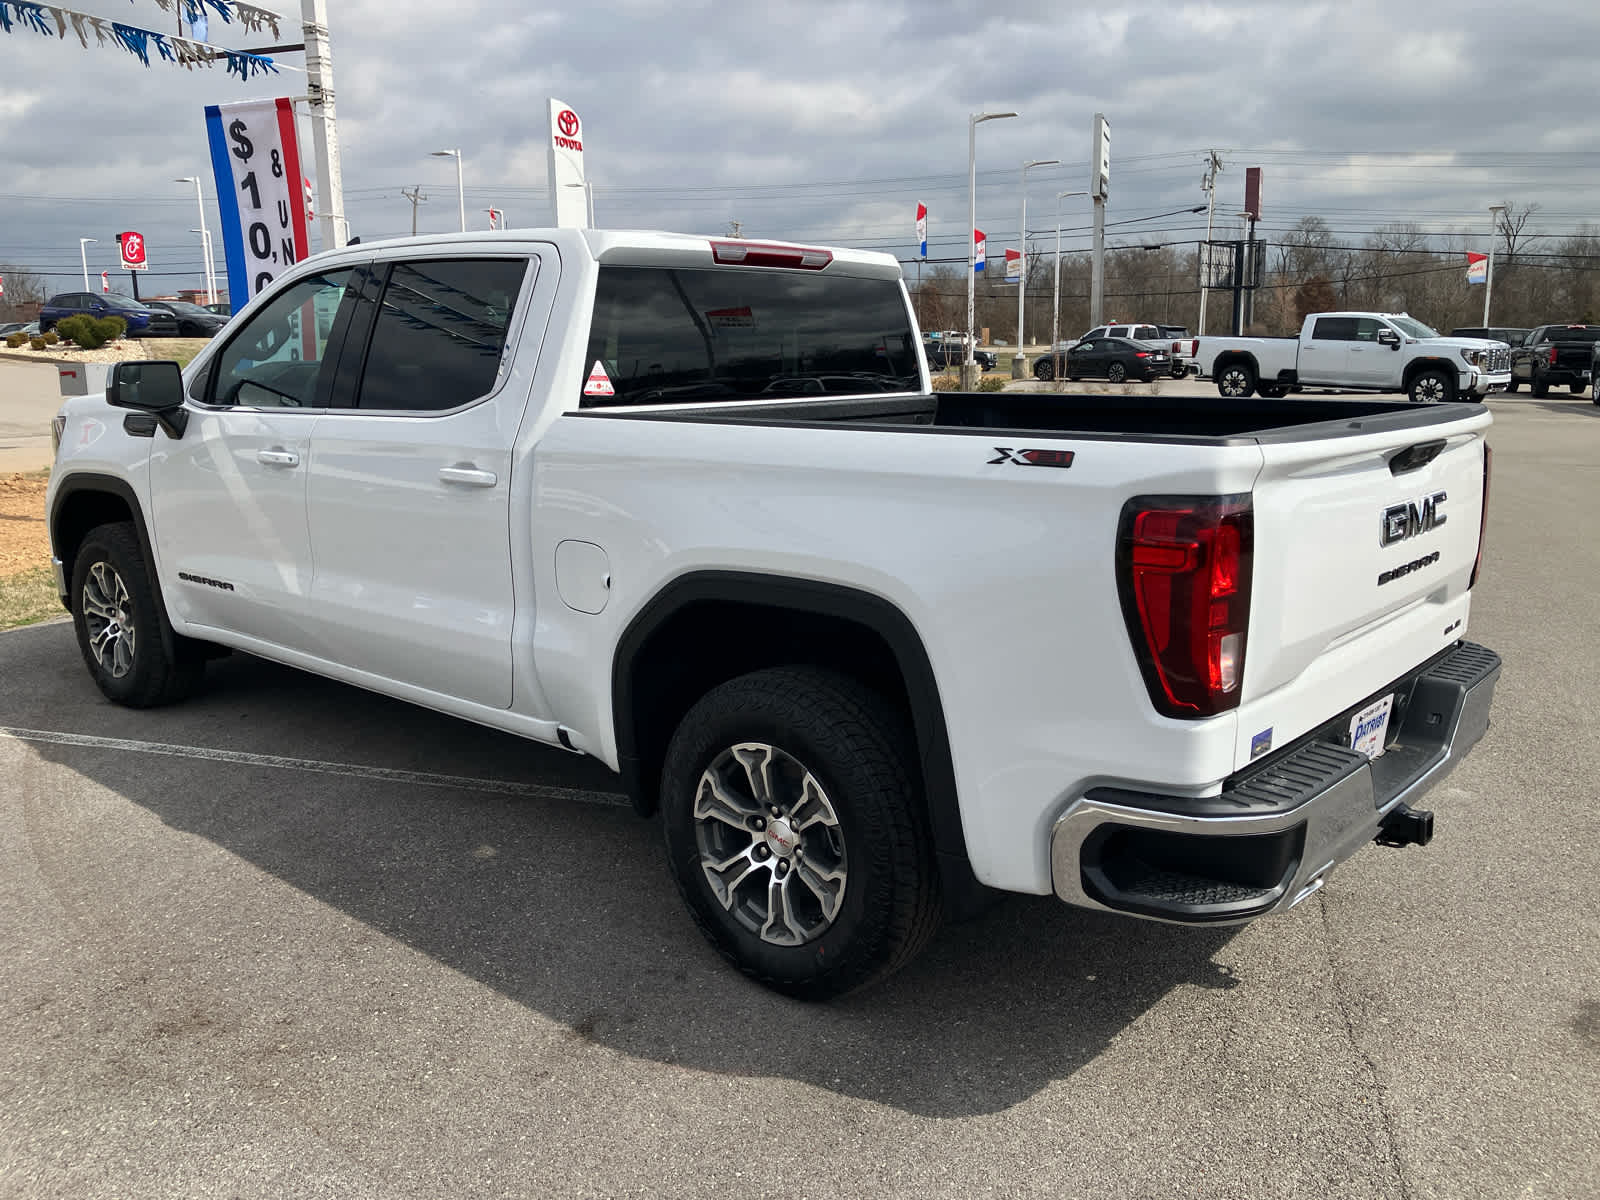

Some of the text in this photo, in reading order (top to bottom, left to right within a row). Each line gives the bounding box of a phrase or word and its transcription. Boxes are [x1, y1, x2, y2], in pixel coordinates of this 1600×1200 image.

[554, 136, 583, 152] TOYOTA
[270, 149, 283, 178] &
[1380, 490, 1448, 548] GMC
[178, 571, 234, 592] SIERRA
[1377, 551, 1440, 586] SIERRA
[1352, 711, 1387, 750] PATRIOT
[767, 829, 792, 849] GMC
